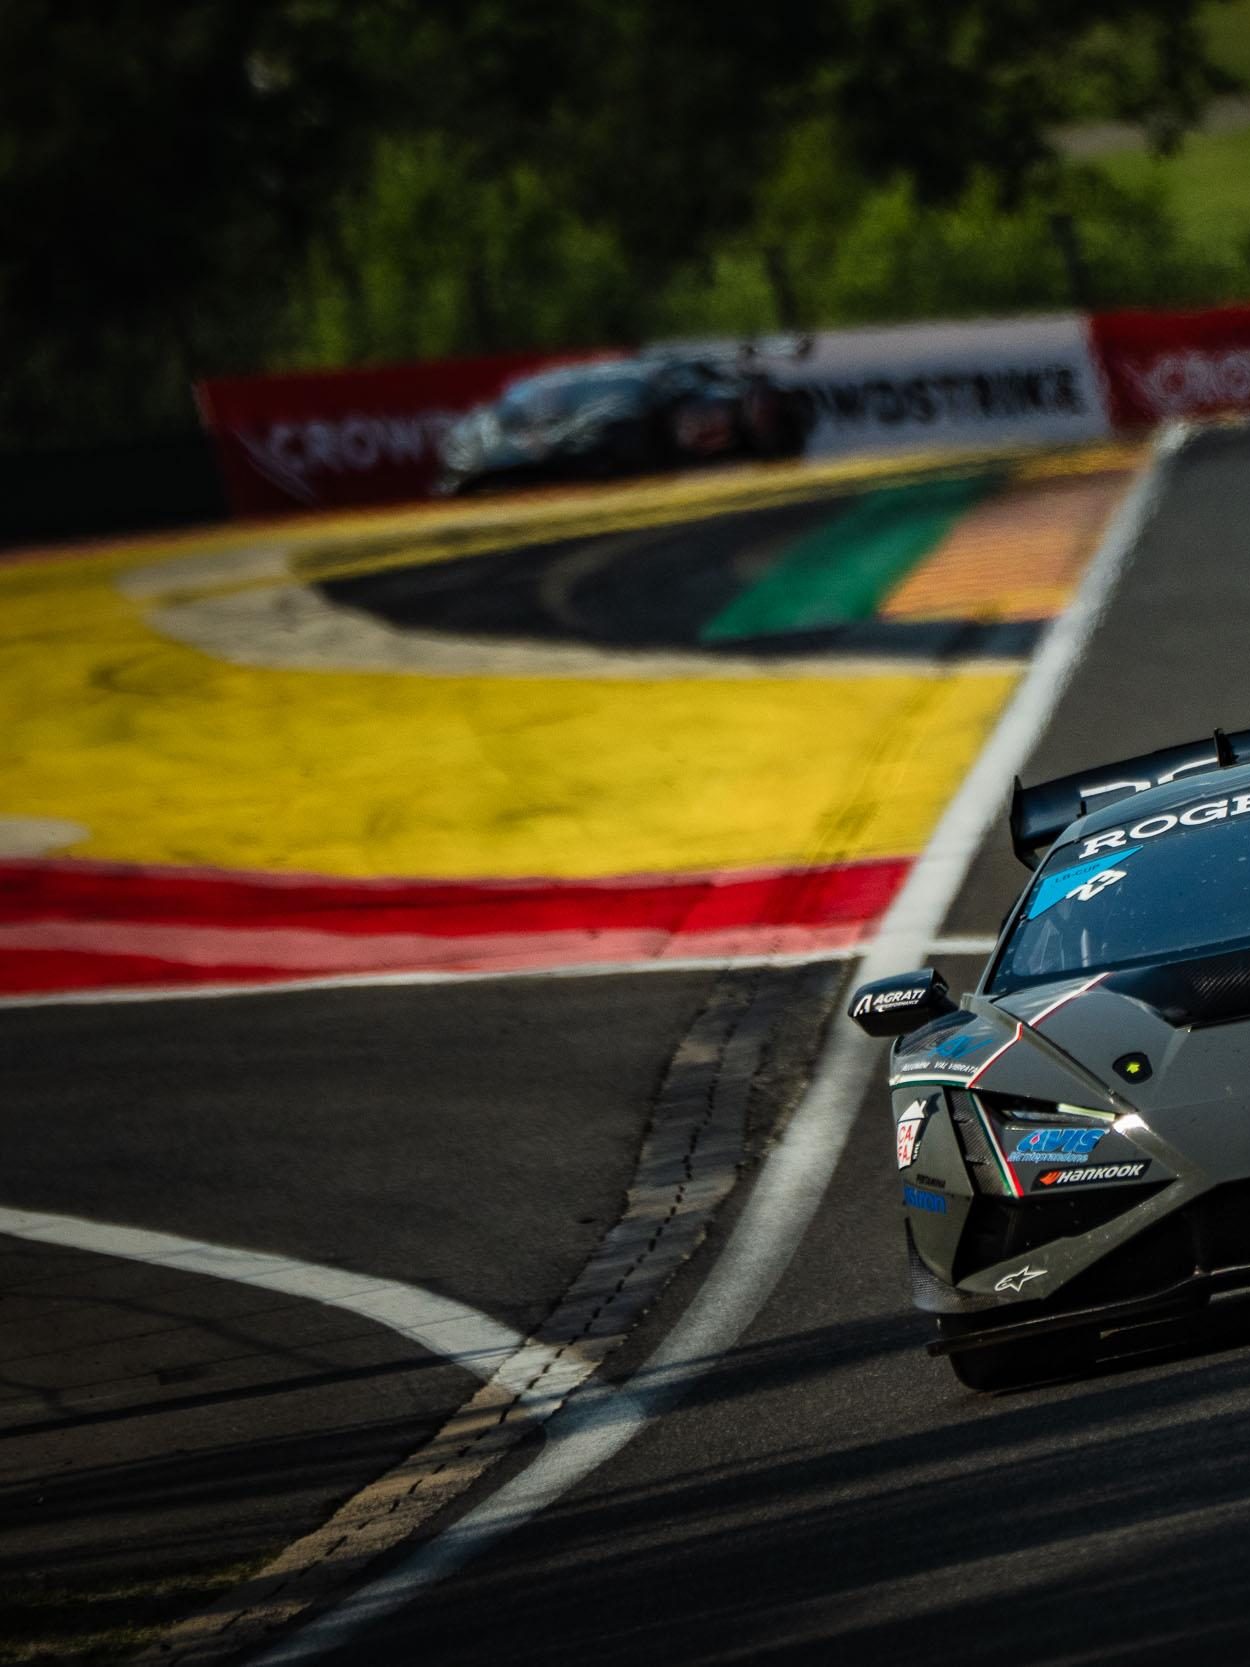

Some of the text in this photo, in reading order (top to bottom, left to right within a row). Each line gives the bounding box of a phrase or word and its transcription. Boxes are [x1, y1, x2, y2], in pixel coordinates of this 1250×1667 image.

[1065, 869, 1128, 902] 23
[873, 988, 927, 1006] AGRATI
[1016, 1128, 1109, 1153] AVIS
